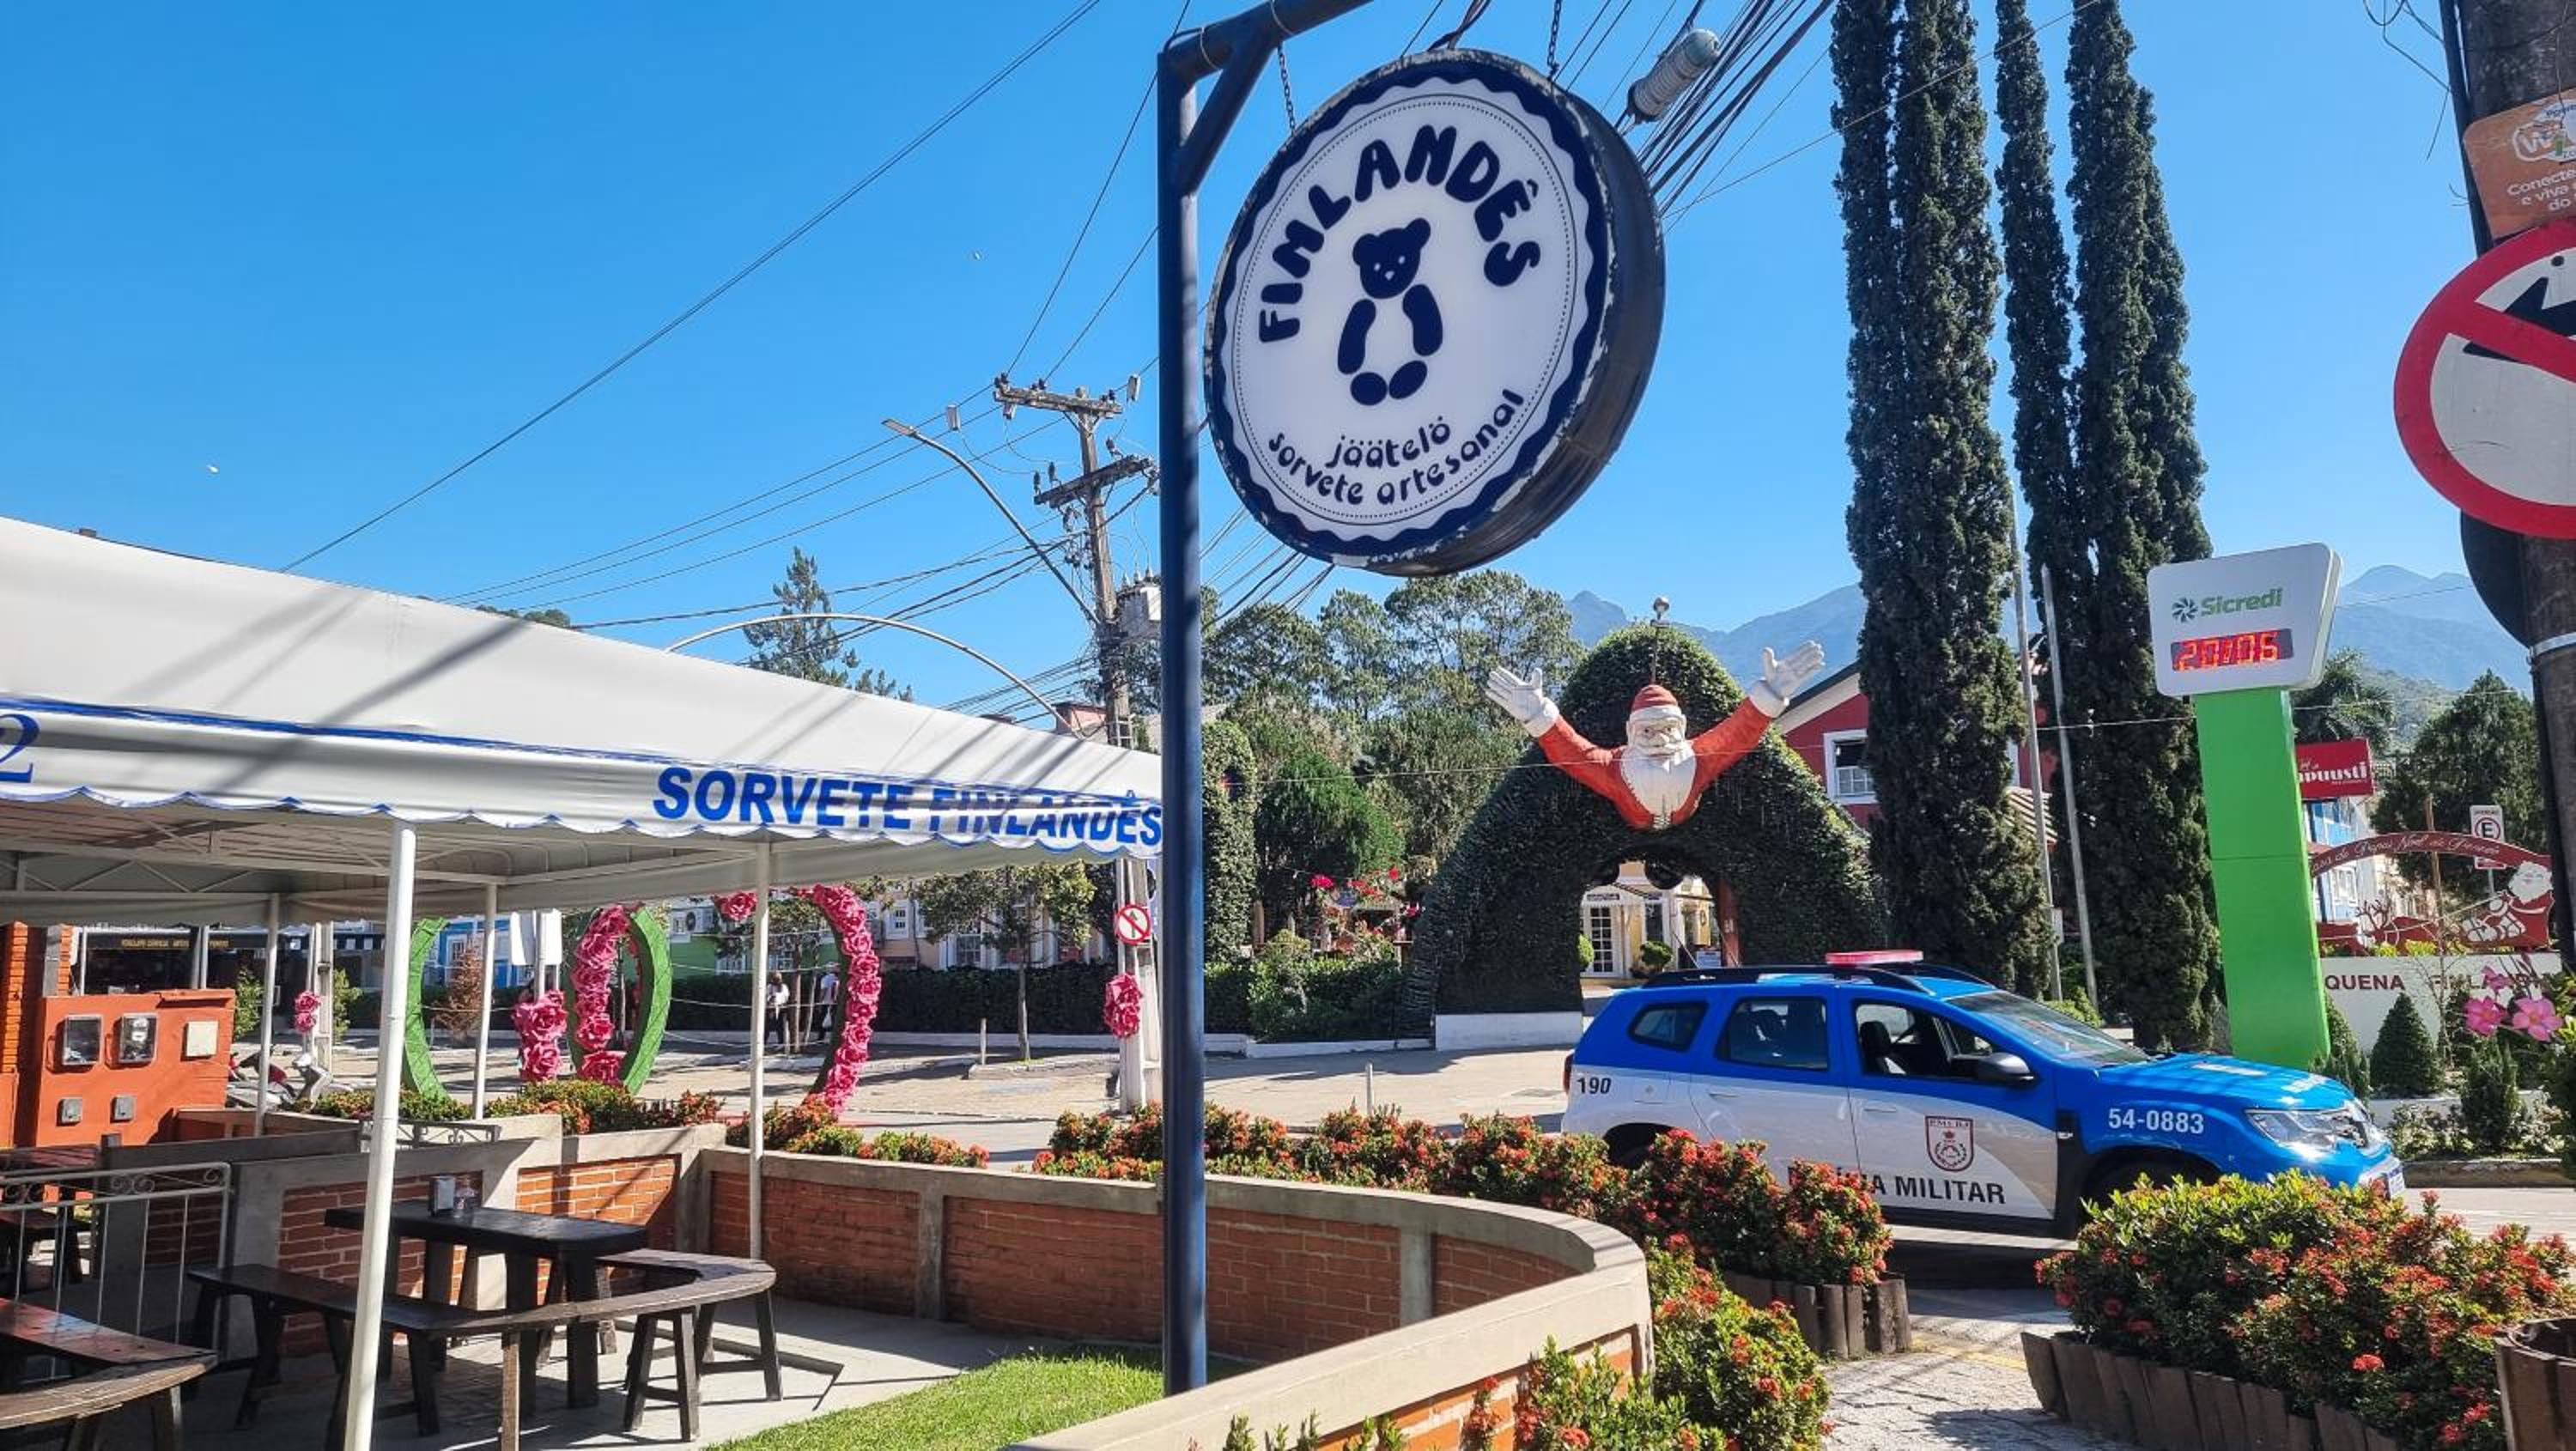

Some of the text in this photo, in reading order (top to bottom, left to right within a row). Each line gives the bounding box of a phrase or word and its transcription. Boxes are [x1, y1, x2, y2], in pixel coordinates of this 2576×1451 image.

[2536, 185, 2569, 201] viva
[1268, 387, 1525, 505] sorvete artesanal
[1326, 415, 1452, 469] jäätelö
[2201, 587, 2284, 616] Sicredi
[653, 767, 1163, 846] SORVETE FINLANDÊS
[2482, 823, 2494, 838] E
[2324, 974, 2406, 990] QUENA
[1577, 1076, 1612, 1095] 190
[2108, 1108, 2204, 1134] 54-0883
[1895, 1176, 2006, 1204] MILITAR
